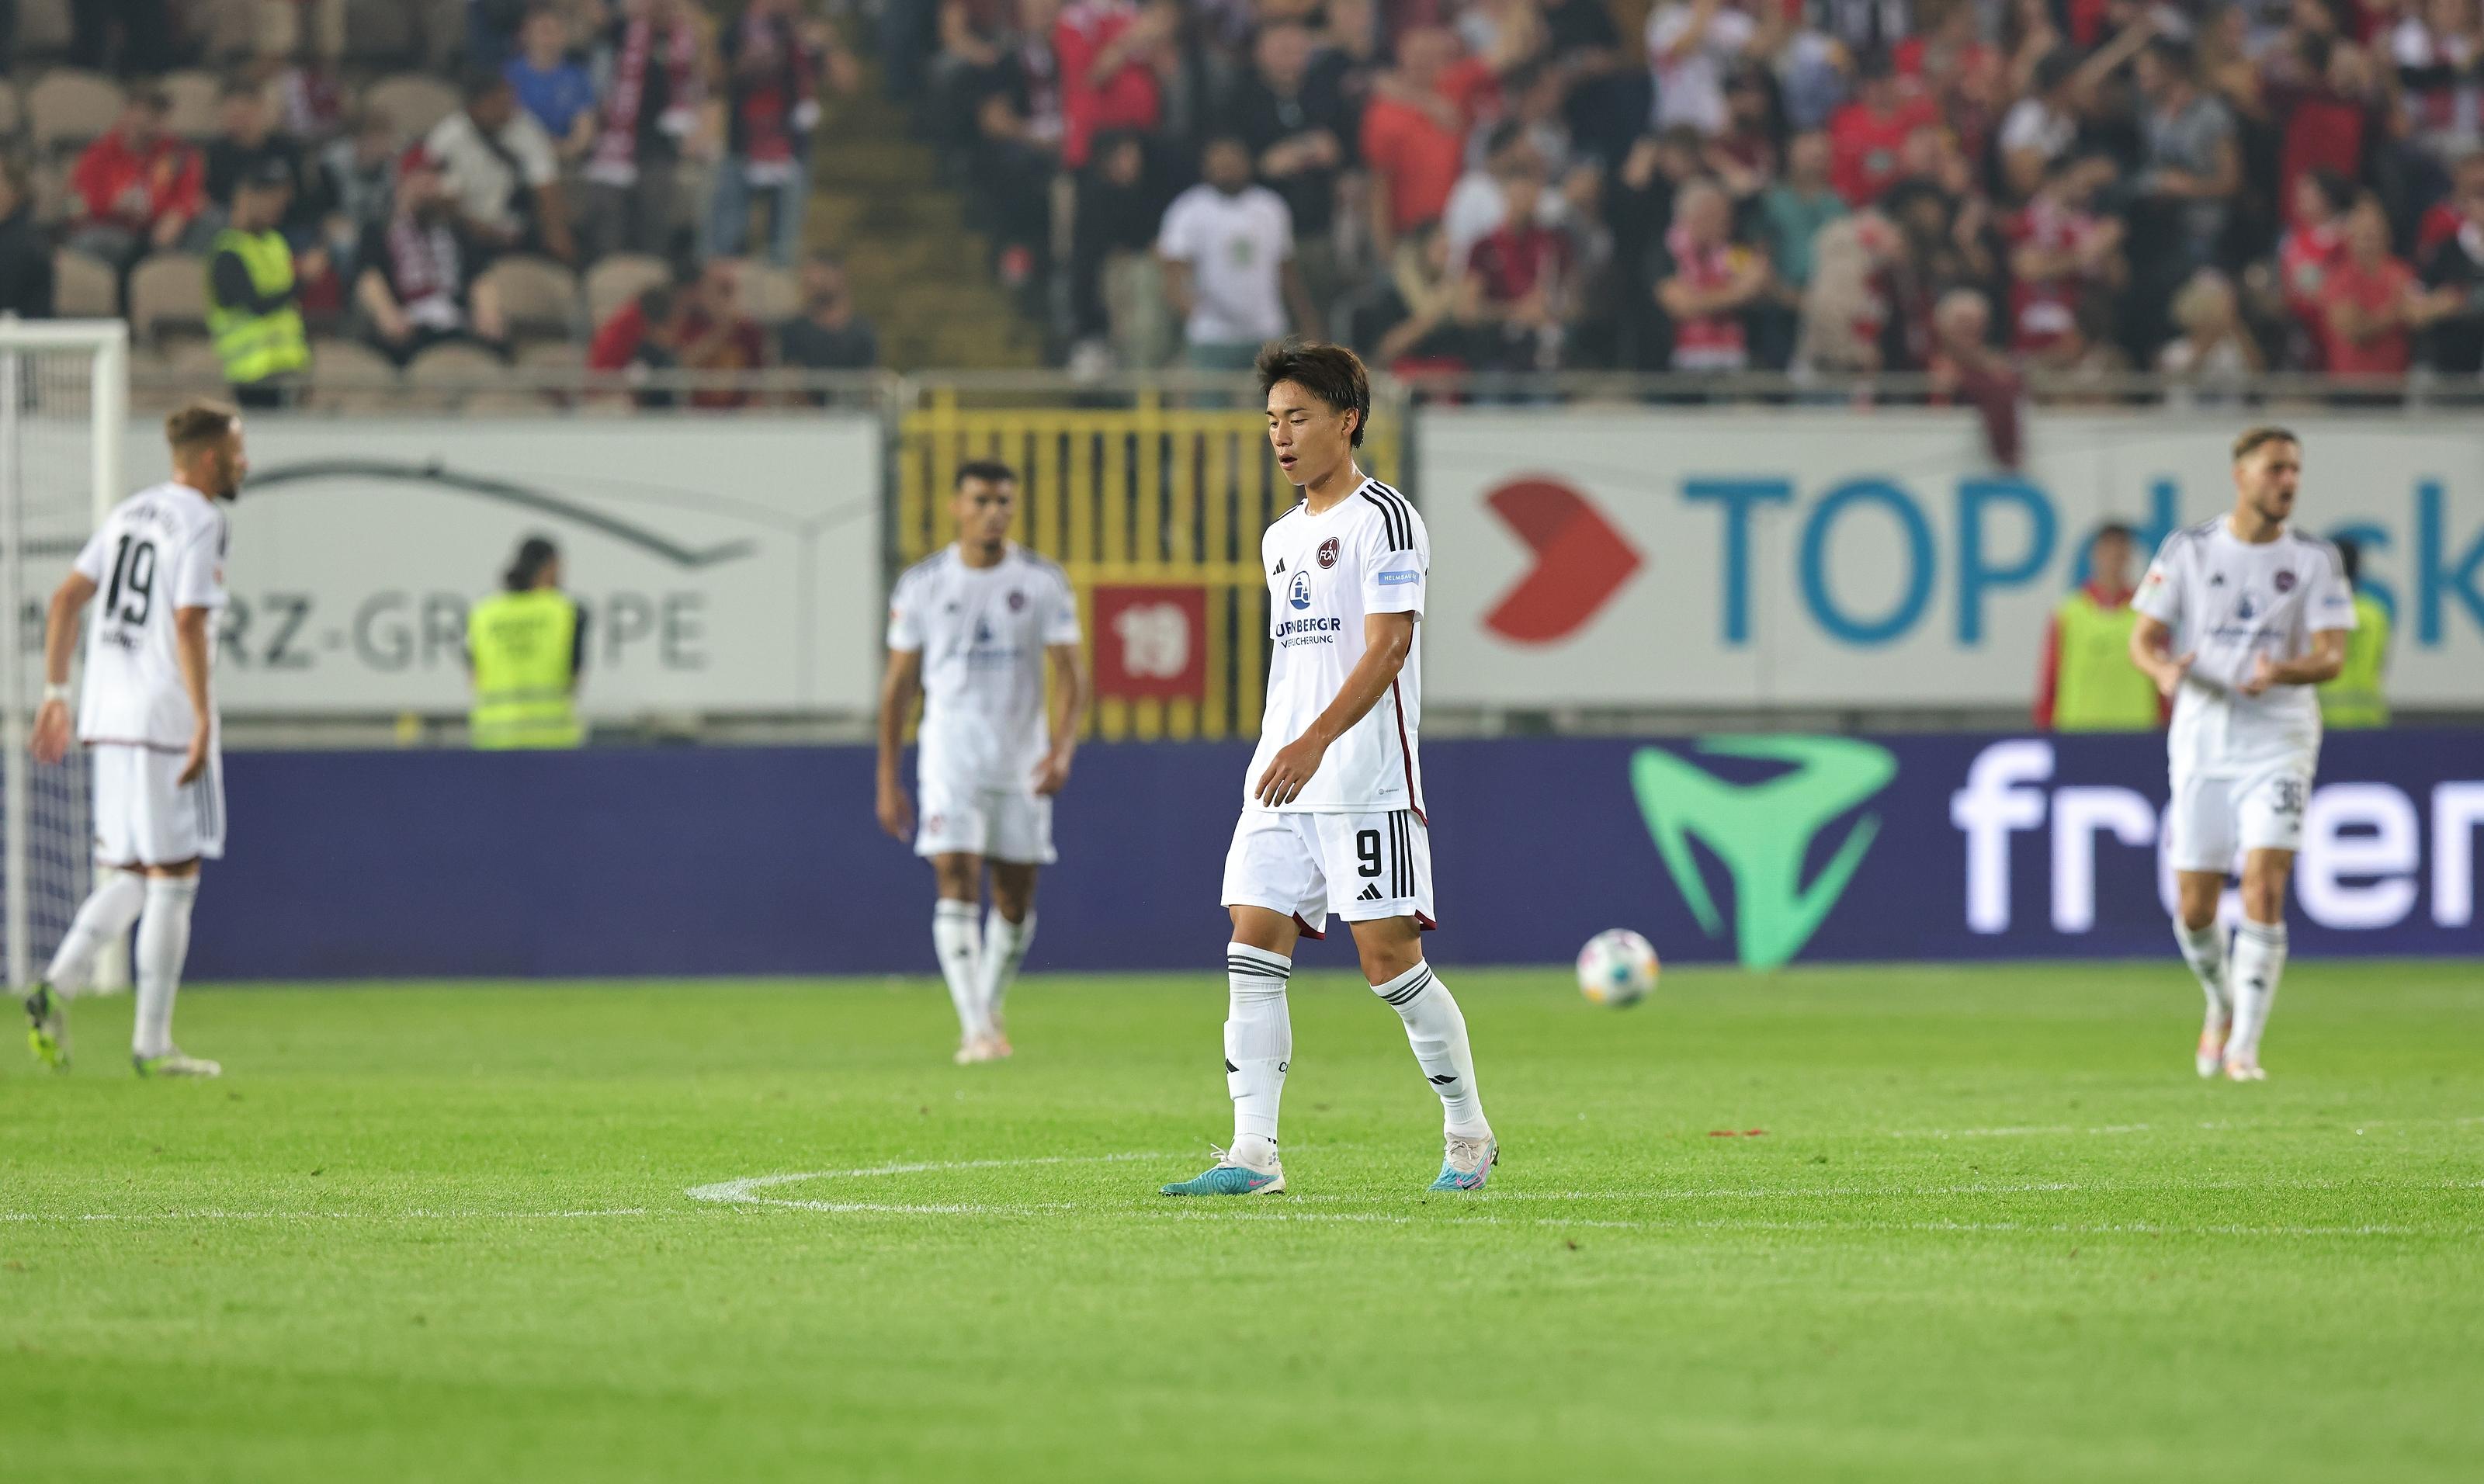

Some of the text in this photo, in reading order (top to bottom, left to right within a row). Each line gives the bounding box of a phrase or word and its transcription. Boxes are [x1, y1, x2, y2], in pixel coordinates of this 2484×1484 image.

[106, 533, 155, 626] 19
[1319, 549, 1337, 561] FCN
[1356, 829, 1382, 878] 9
